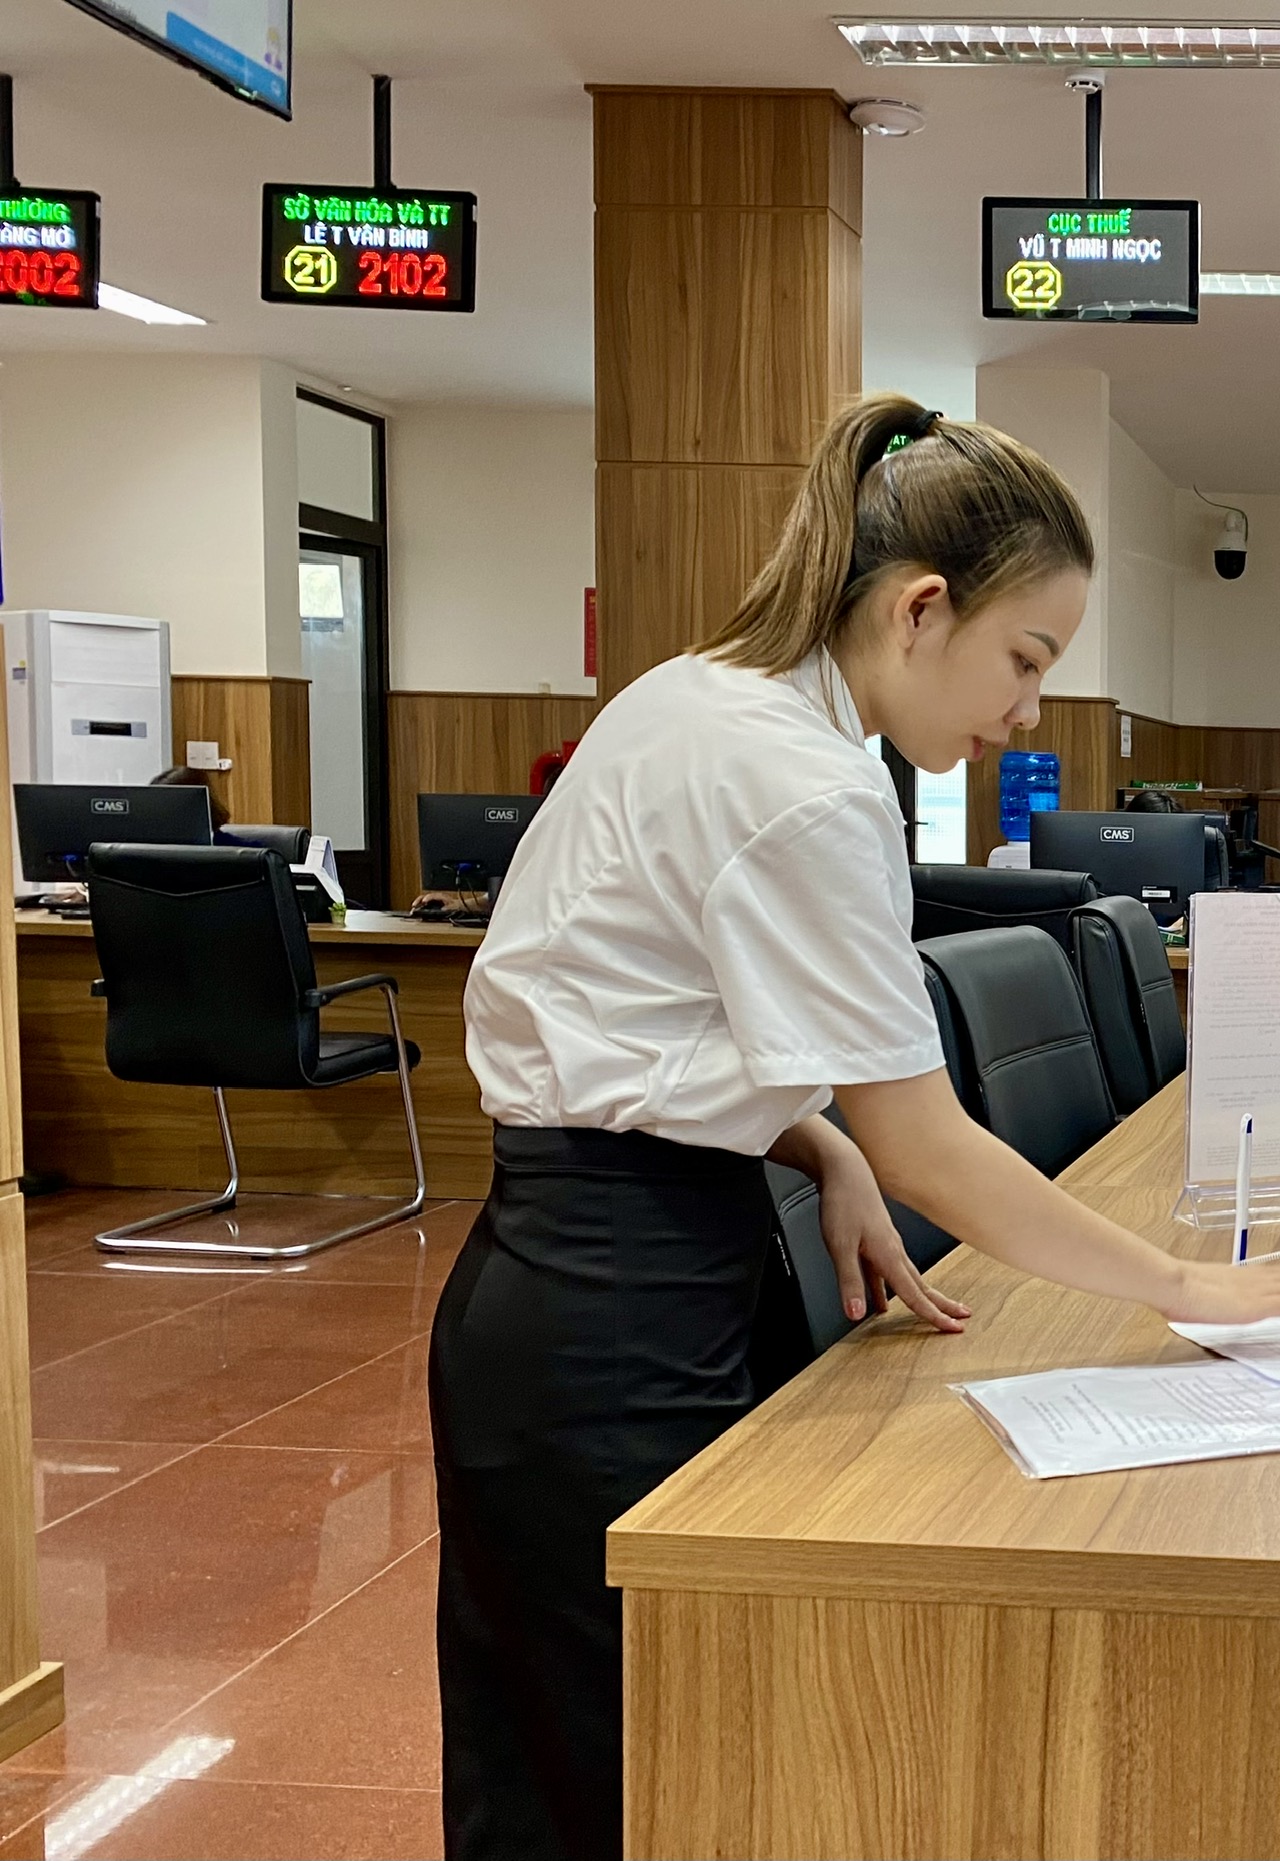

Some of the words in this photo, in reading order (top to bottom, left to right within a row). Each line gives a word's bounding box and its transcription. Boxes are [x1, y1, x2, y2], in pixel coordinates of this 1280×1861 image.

[428, 204, 451, 226] TT
[1048, 212, 1081, 236] CỤC
[1087, 208, 1132, 234] THUẾ
[304, 221, 327, 244] LÊ
[331, 226, 344, 245] T
[389, 225, 429, 249] BÌNH
[1019, 233, 1045, 258] VŨ
[1050, 238, 1062, 259] T
[1066, 238, 1107, 260] MINH
[1112, 238, 1162, 263] NGỌC
[0, 250, 80, 295] 002
[293, 253, 328, 285] 21
[359, 251, 447, 296] 2102
[1012, 268, 1055, 298] 22
[94, 801, 125, 811] CMS
[488, 810, 515, 820] CMS
[1103, 829, 1131, 840] CMS
